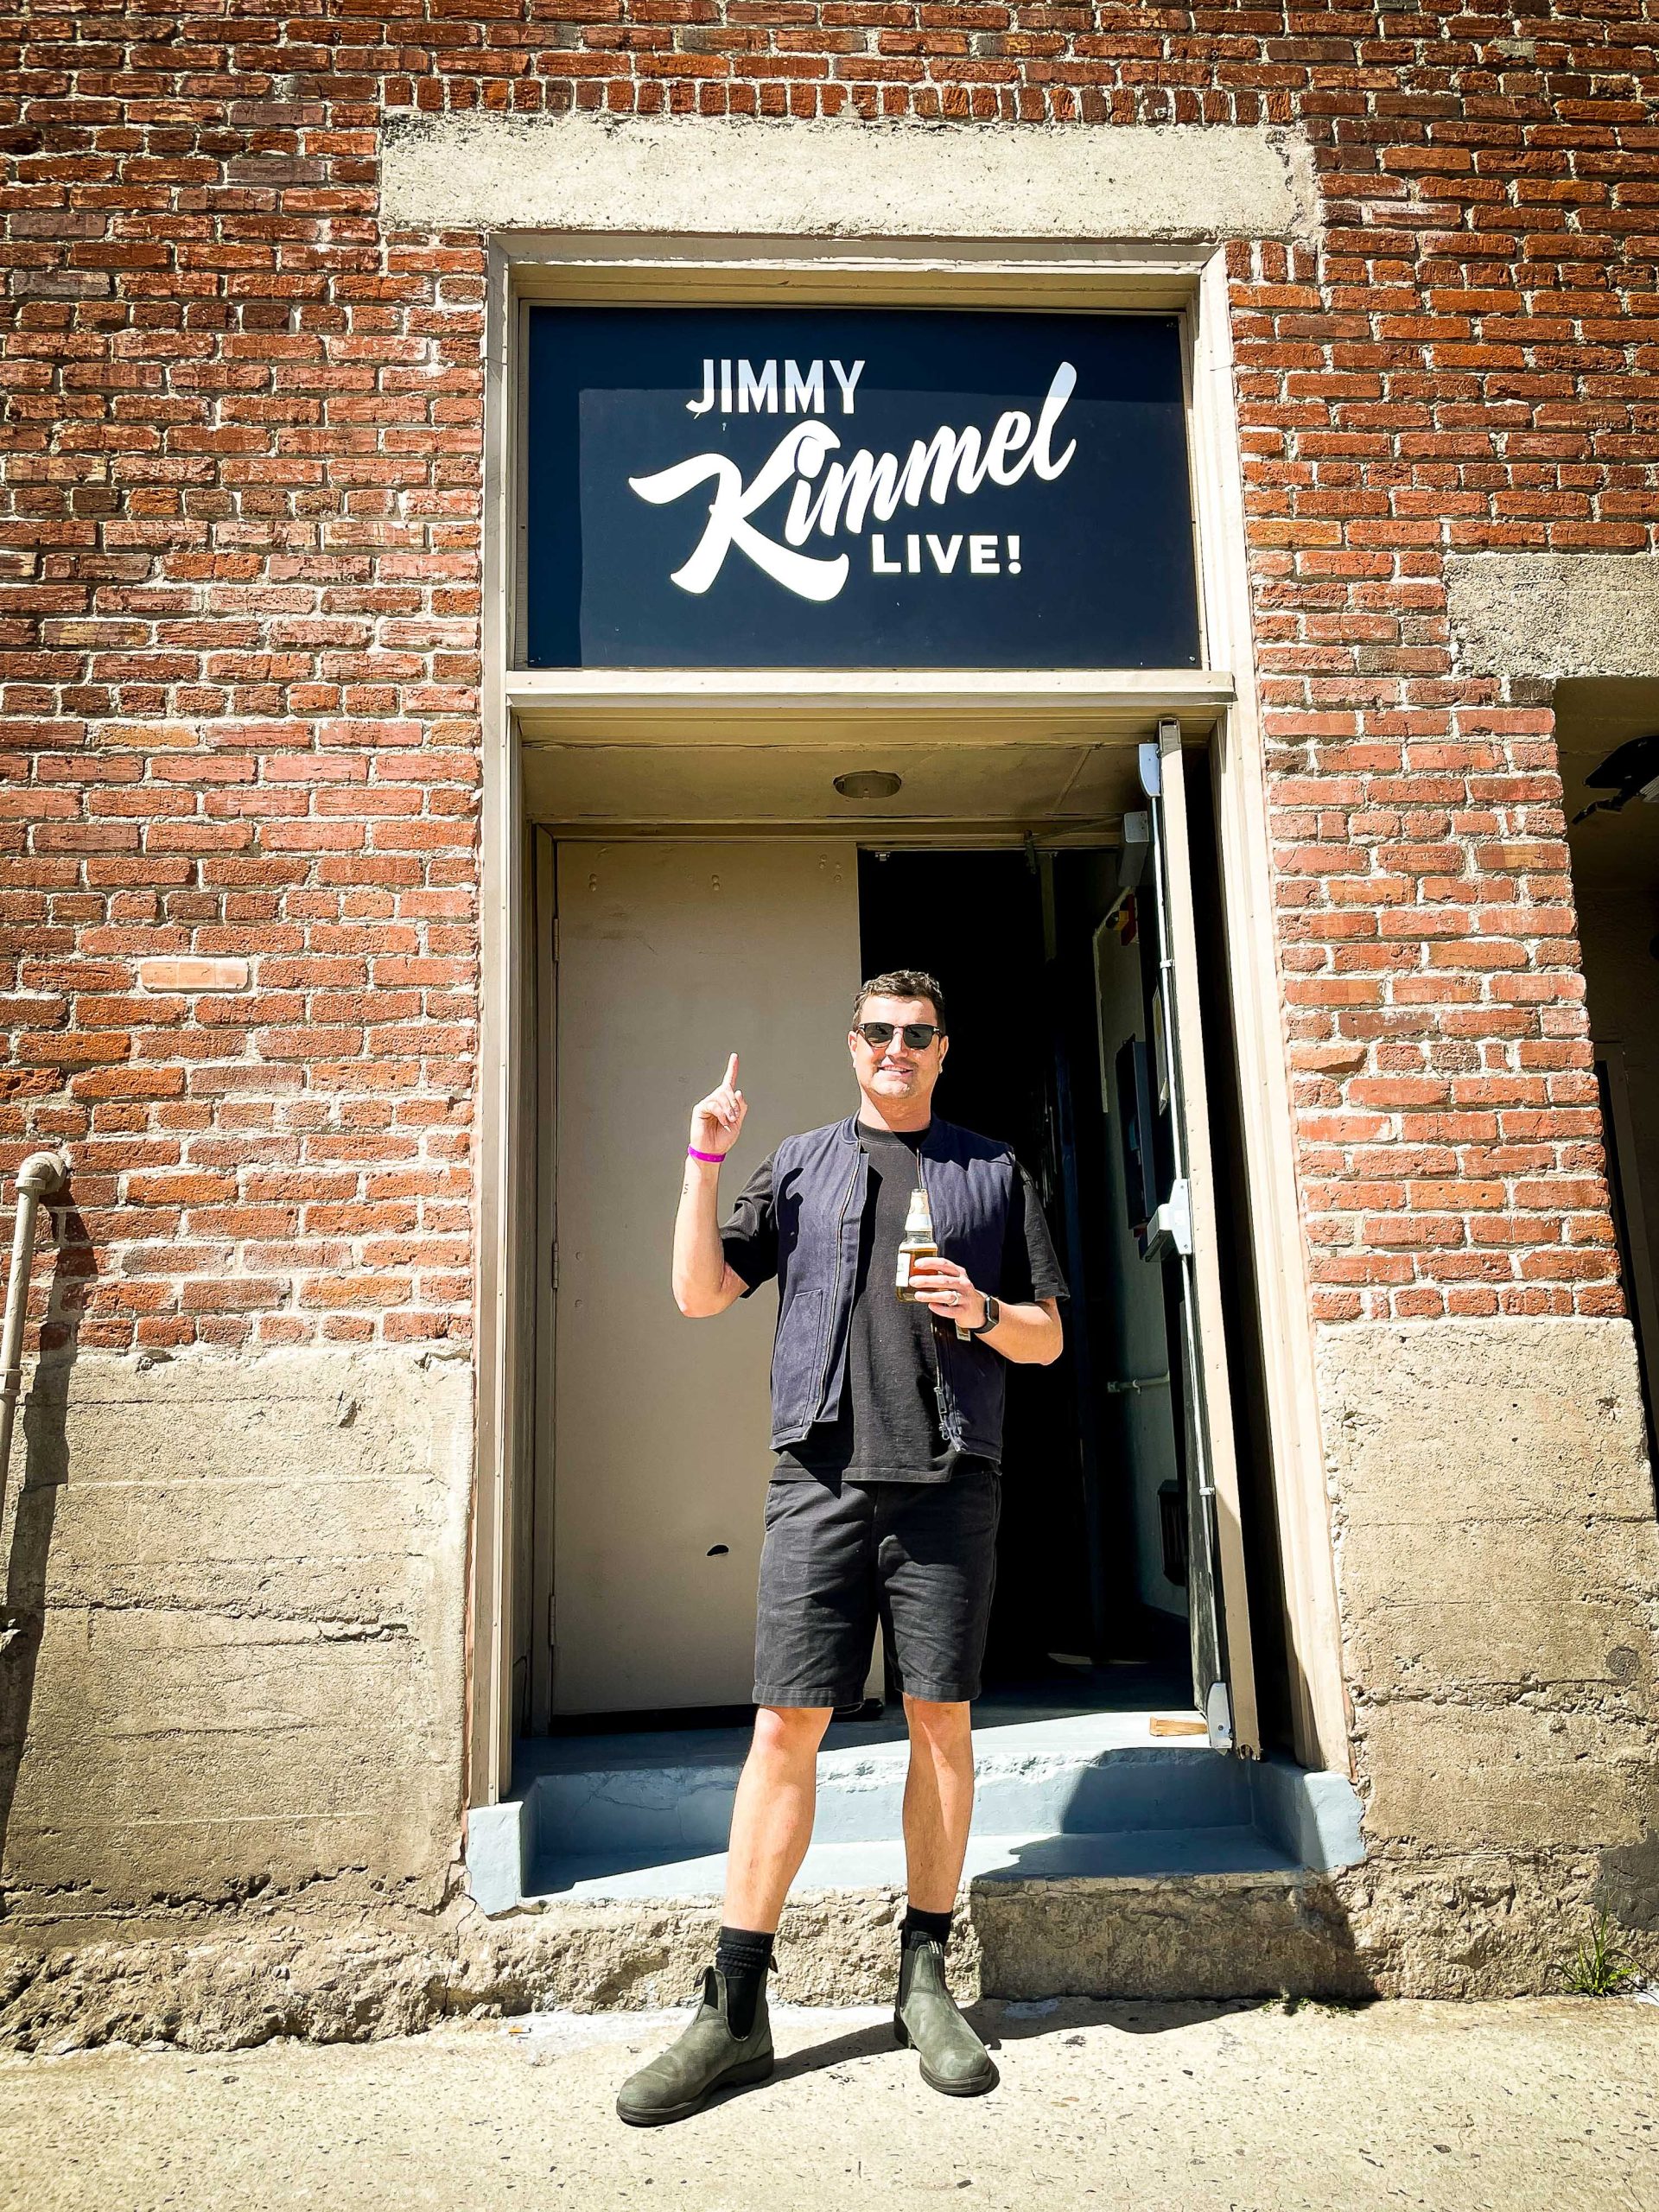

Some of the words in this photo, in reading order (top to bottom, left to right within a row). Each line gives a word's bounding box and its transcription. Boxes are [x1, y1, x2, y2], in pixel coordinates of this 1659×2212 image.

[686, 359, 866, 416] JIMMY
[629, 361, 1077, 601] Kimmel
[871, 533, 1022, 575] LIVE!
